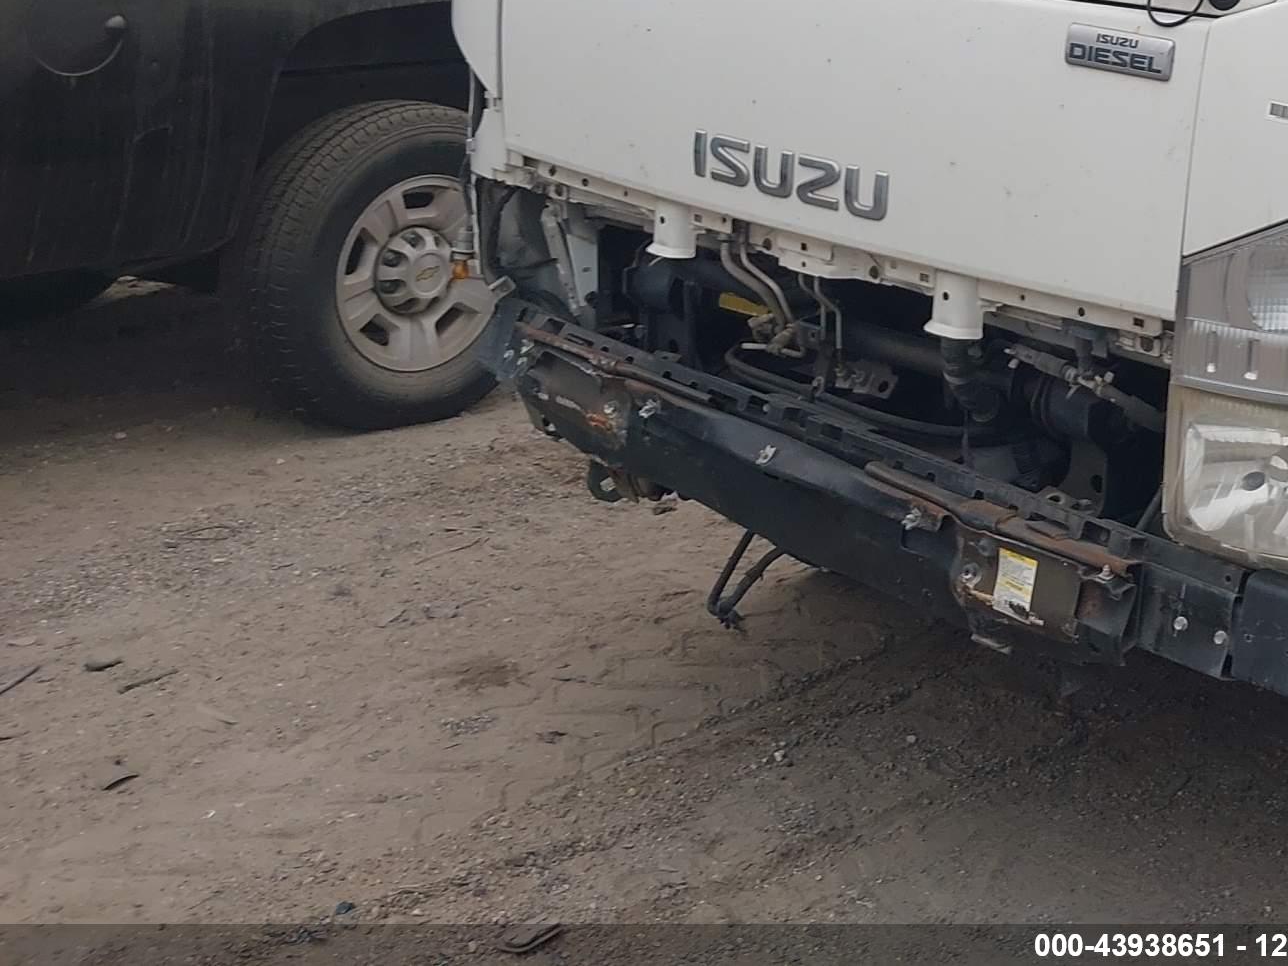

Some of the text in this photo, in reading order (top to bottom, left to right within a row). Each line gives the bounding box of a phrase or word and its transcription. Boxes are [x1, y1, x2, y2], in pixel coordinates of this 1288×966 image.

[1096, 33, 1139, 48] ISUZU
[1069, 43, 1162, 74] DIESEL
[694, 129, 889, 221] ISUZU
